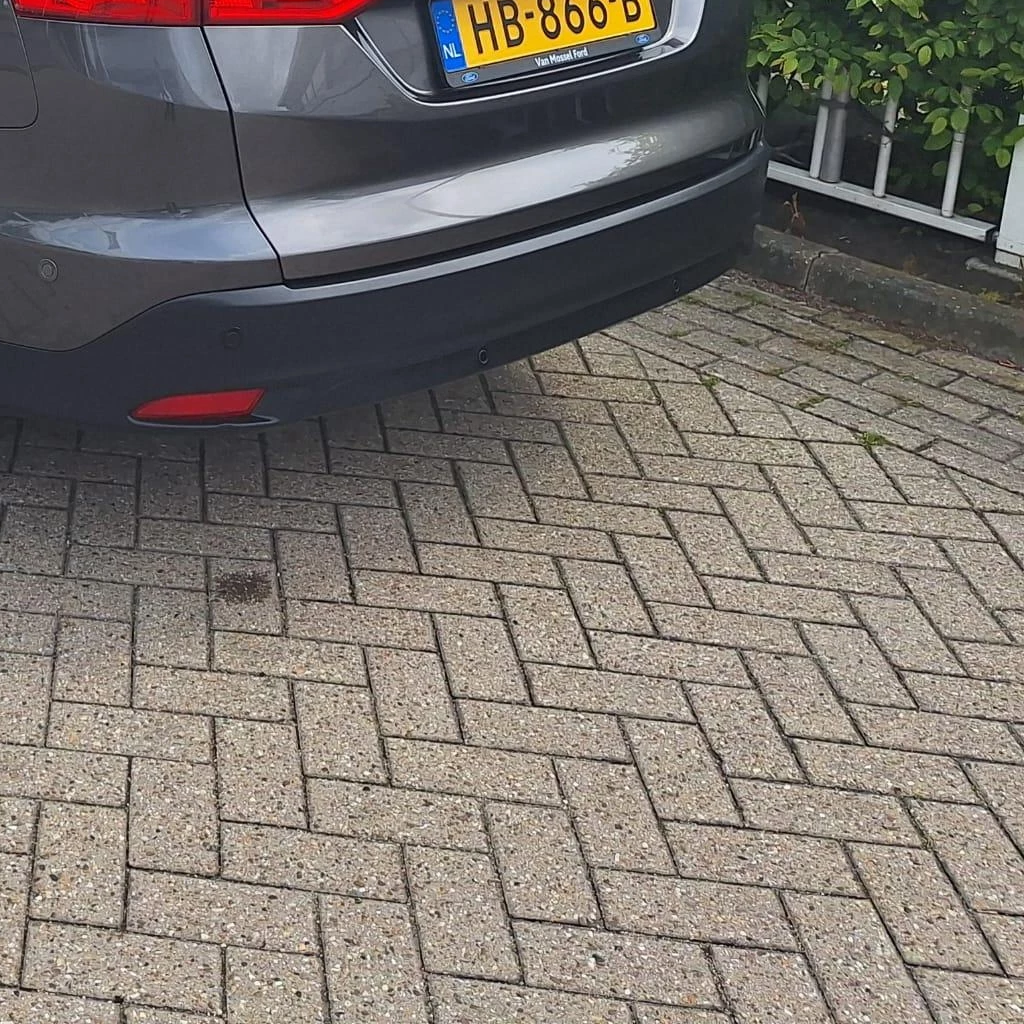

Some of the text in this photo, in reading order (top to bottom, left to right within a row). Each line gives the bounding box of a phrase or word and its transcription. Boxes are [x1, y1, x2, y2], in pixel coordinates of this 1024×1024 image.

[442, 42, 462, 59] NL
[534, 46, 589, 67] Van Mossel Ford
